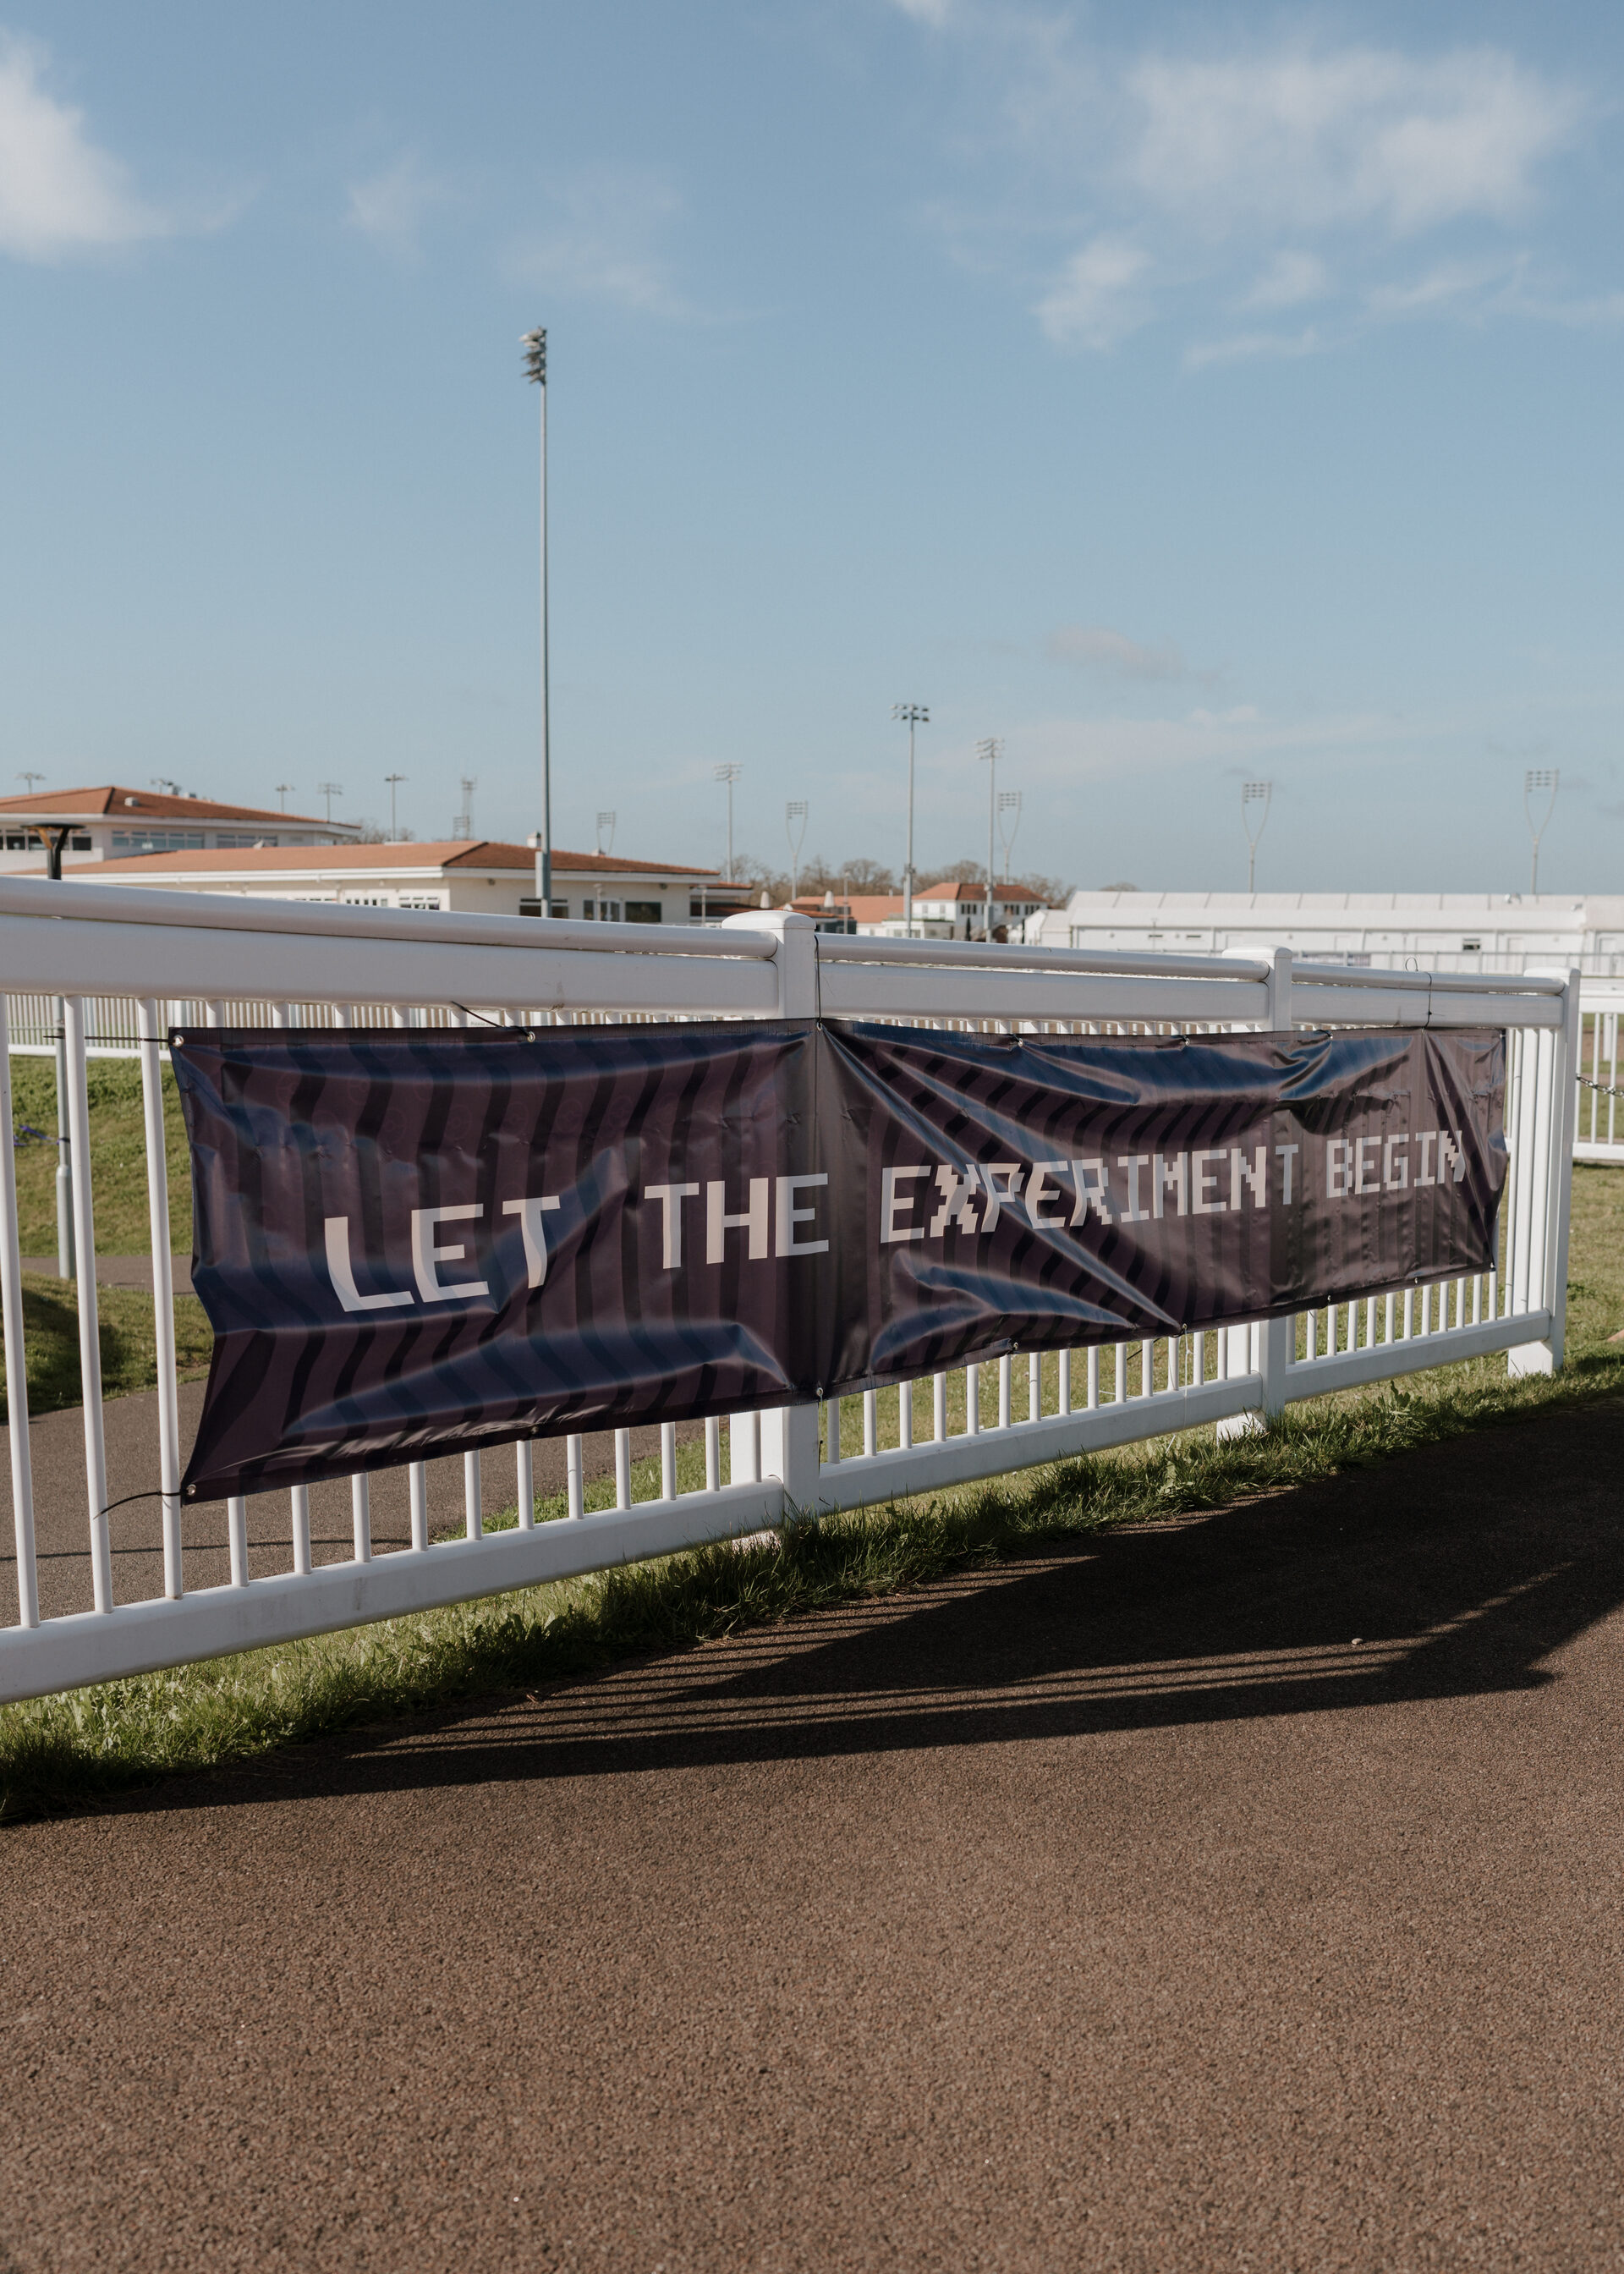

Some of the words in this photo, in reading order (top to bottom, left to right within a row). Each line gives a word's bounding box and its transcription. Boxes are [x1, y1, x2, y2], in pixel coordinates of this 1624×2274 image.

[325, 1196, 561, 1312] LET
[644, 1173, 829, 1270] THE
[881, 1143, 1299, 1244] EXPERIMENT
[1325, 1130, 1466, 1199] BEGIN
